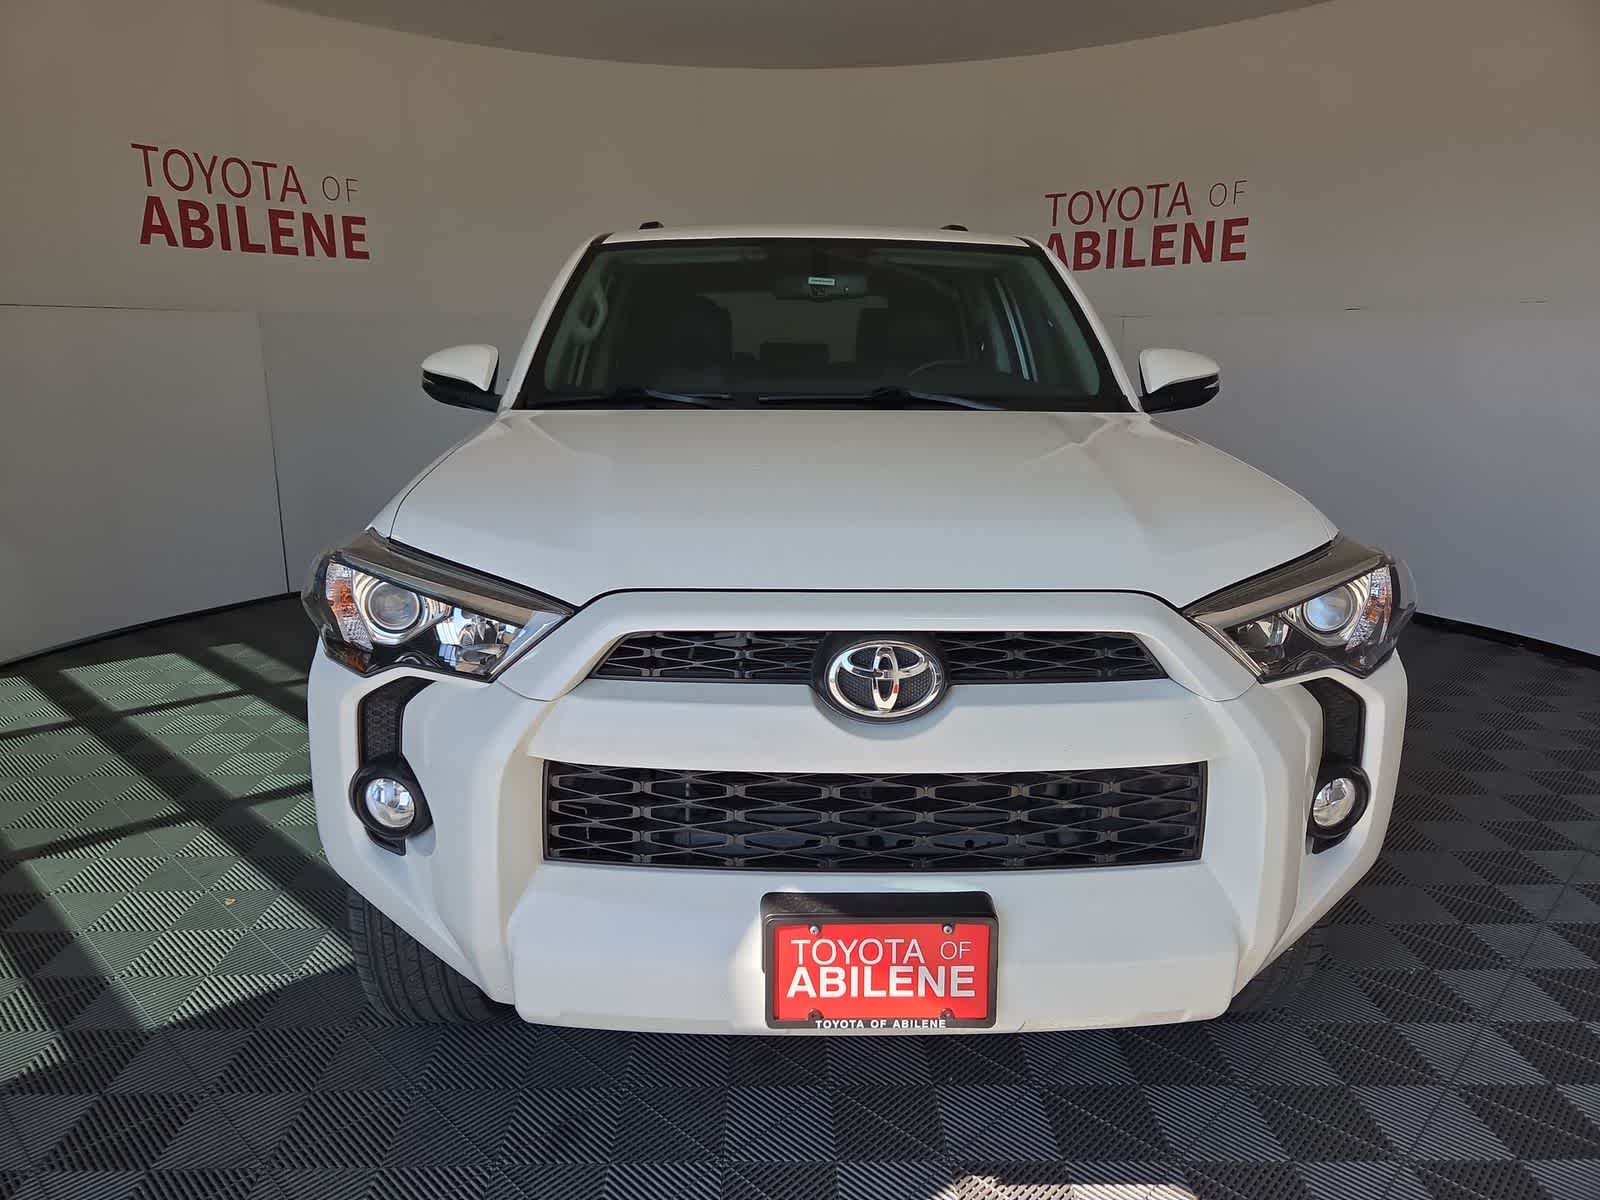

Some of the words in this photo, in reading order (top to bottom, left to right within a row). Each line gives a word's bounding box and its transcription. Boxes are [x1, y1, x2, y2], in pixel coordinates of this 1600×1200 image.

[130, 142, 308, 205] TOYOTA
[321, 175, 359, 203] OF
[1044, 180, 1193, 227] TOYOTA
[1208, 180, 1248, 208] OF
[139, 195, 371, 261] ABILENE
[1046, 216, 1250, 272] ABILENE
[790, 937, 926, 966] TOYOTA
[939, 940, 973, 961] OF
[785, 965, 977, 999] ABILENE
[815, 1019, 865, 1029] TOYOTA
[870, 1019, 888, 1029] OF
[892, 1019, 947, 1029] ABILENE
